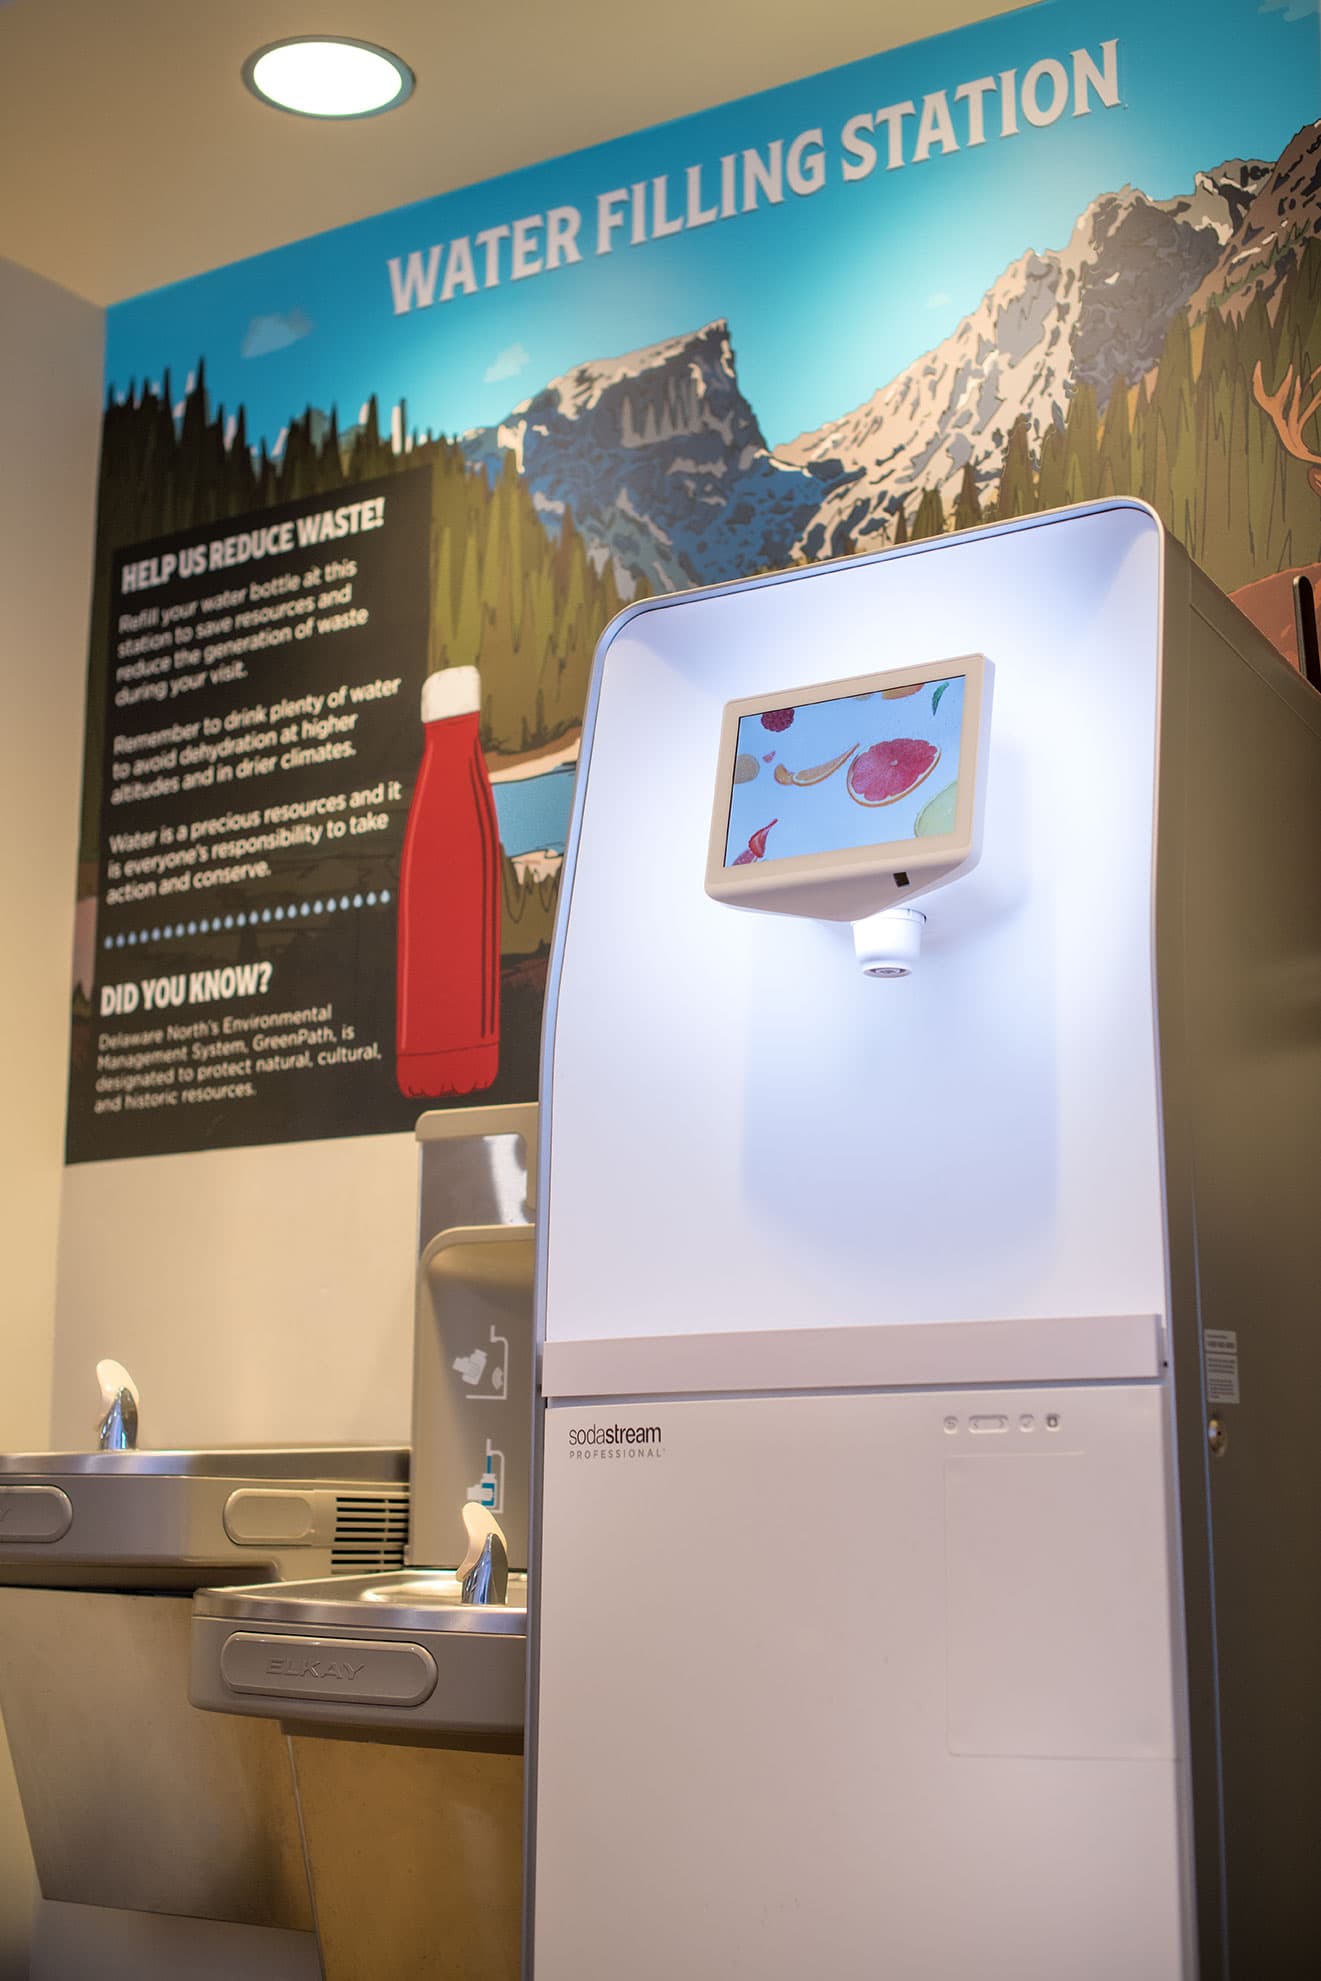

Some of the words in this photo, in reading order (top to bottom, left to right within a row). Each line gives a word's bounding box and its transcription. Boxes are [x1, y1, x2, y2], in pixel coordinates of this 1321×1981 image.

[387, 205, 583, 315] WATER
[595, 128, 826, 256] FILLING
[839, 38, 1122, 181] STATION
[121, 553, 176, 594] HELP
[179, 544, 207, 578] US
[209, 521, 295, 571] REDUCE
[297, 496, 386, 548] WASTE!
[117, 630, 173, 658] station
[175, 625, 194, 645] to
[196, 616, 233, 639] save
[235, 596, 315, 629] resources
[317, 583, 352, 608] and
[119, 607, 160, 633] Refill
[161, 601, 198, 626] your
[200, 587, 248, 613] water
[249, 572, 301, 601] bottle
[302, 565, 322, 587] at
[324, 559, 357, 581] this
[116, 655, 172, 682] reduce
[174, 648, 201, 669] the
[203, 625, 293, 664] generation
[294, 617, 315, 640] of
[317, 608, 369, 634] waste
[115, 680, 168, 707] during
[170, 671, 208, 697] your
[210, 660, 248, 684] visit.
[112, 762, 131, 780] to
[132, 750, 177, 776] avoid
[179, 729, 278, 766] dehydration
[280, 723, 299, 743] at
[301, 713, 359, 740] higher
[113, 721, 201, 755] Remember
[203, 717, 222, 736] to
[224, 705, 268, 731] drink
[269, 693, 325, 724] plenty
[326, 685, 348, 709] of
[349, 677, 402, 703] water
[111, 775, 180, 805] altitudes
[182, 765, 215, 790] and
[216, 762, 233, 783] in
[235, 755, 277, 778] drier
[280, 740, 357, 770] climates.
[107, 859, 122, 880] is
[123, 842, 209, 873] everyone's
[211, 824, 323, 860] responsibility
[326, 818, 347, 839] to
[349, 811, 389, 836] take
[109, 829, 158, 854] Water
[159, 824, 174, 845] is
[176, 824, 188, 842] a
[190, 809, 261, 840] precious
[264, 792, 347, 825] resources
[349, 782, 384, 808] and
[387, 780, 402, 801] it
[106, 879, 157, 906] action
[159, 871, 191, 896] and
[193, 860, 272, 888] conserve.
[100, 982, 139, 1017] DID
[141, 974, 186, 1011] YOU
[189, 960, 273, 1005] KNOW?
[97, 1042, 188, 1072] Management
[191, 1040, 249, 1063] System,
[252, 1025, 338, 1052] GreenPath,
[341, 1024, 355, 1040] is
[99, 1026, 163, 1050] Delaware
[167, 1019, 219, 1043] North's
[222, 1003, 332, 1035] Environmental
[94, 1091, 122, 1114] and
[124, 1088, 178, 1110] historic
[181, 1081, 257, 1103] resources.
[95, 1067, 175, 1093] designated
[177, 1066, 194, 1083] to
[197, 1057, 251, 1085] protect
[255, 1051, 314, 1072] natural,
[317, 1042, 383, 1065] cultural,
[569, 1423, 662, 1446] sodastream
[569, 1448, 662, 1460] PROFESSIONAL
[266, 1657, 365, 1681] ELKAY
